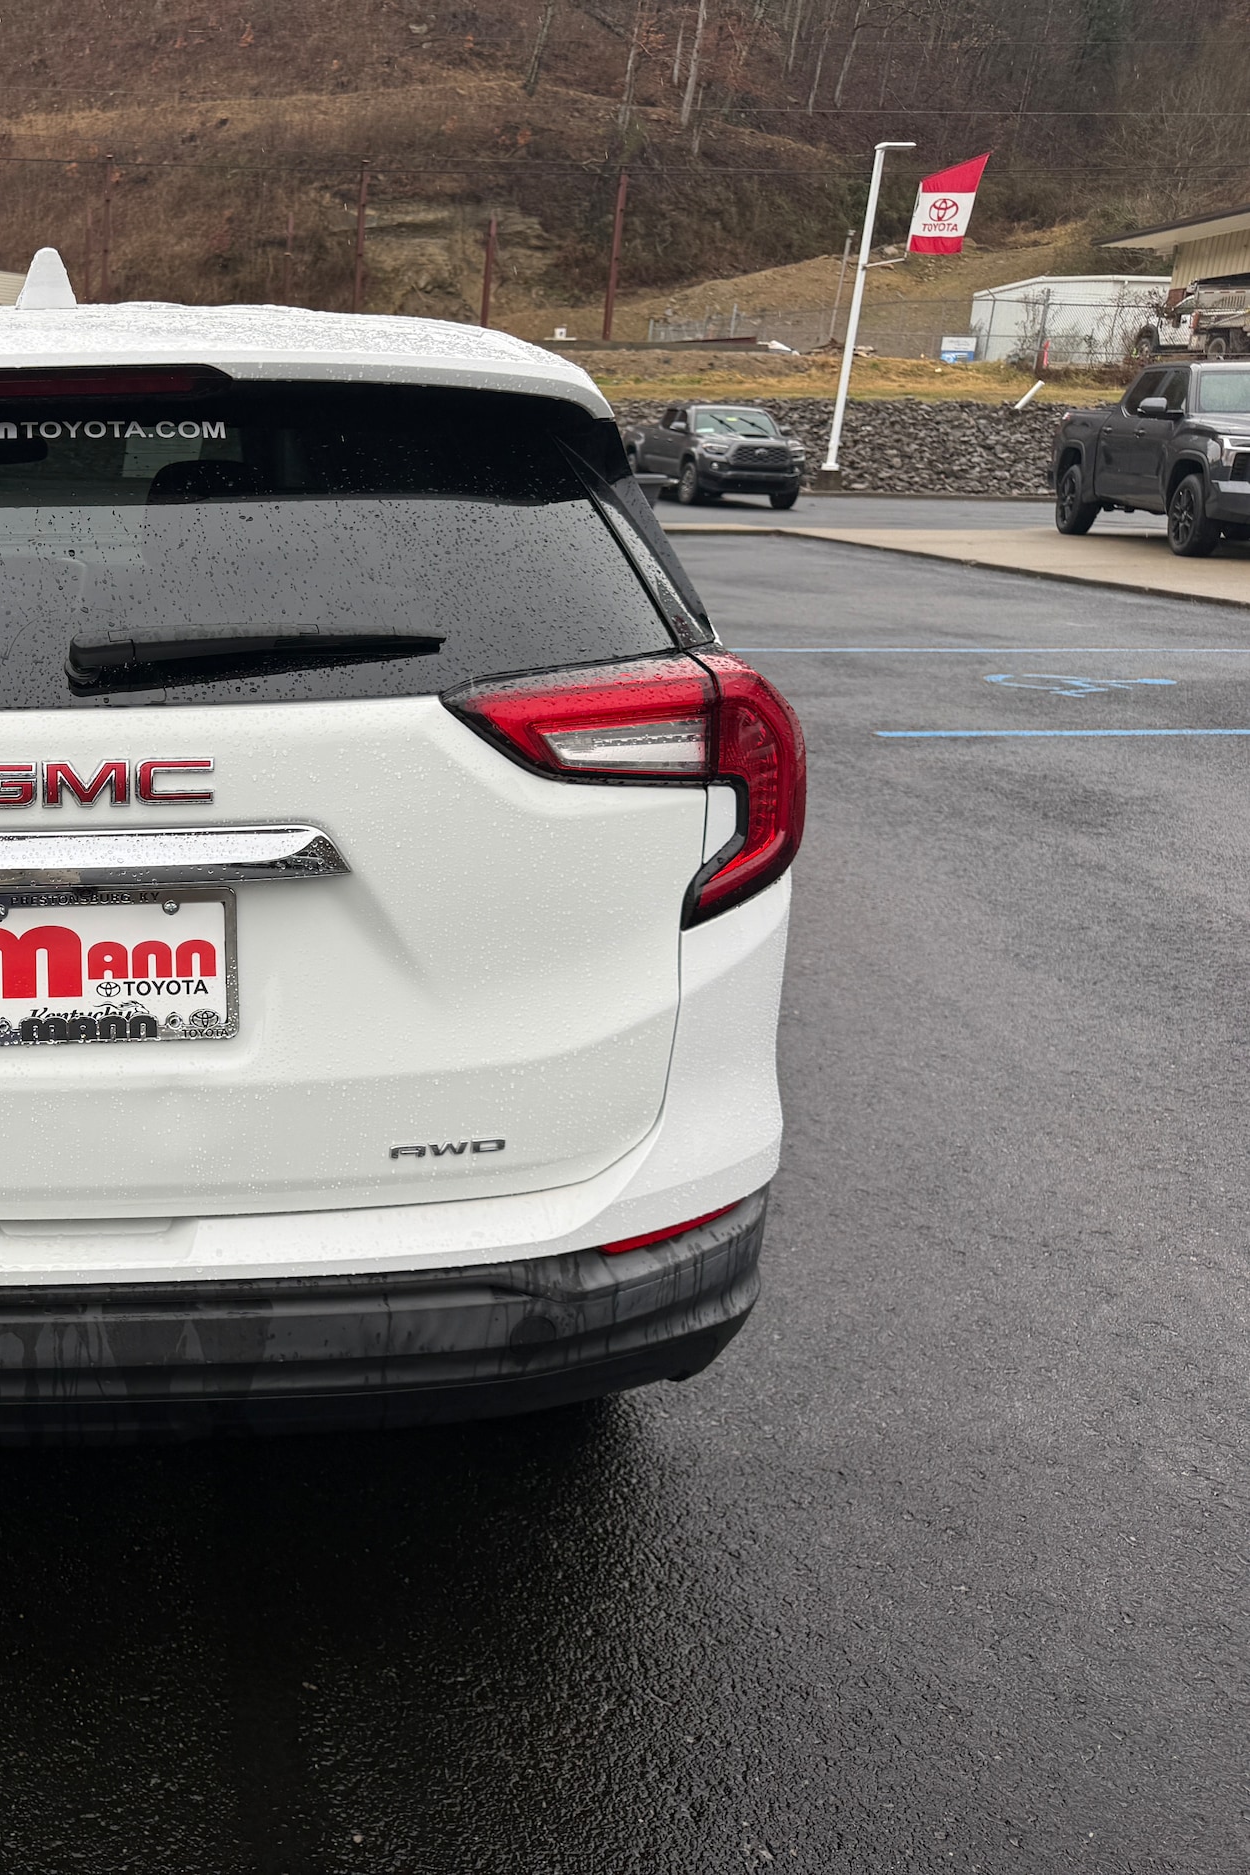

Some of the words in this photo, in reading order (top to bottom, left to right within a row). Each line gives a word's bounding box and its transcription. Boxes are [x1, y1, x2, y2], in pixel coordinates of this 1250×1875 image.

[922, 223, 958, 232] TOYOTA
[139, 891, 161, 903] KY
[124, 979, 209, 996] TOYOTA
[182, 1028, 229, 1039] TOYOTA
[388, 1135, 507, 1159] AWD
